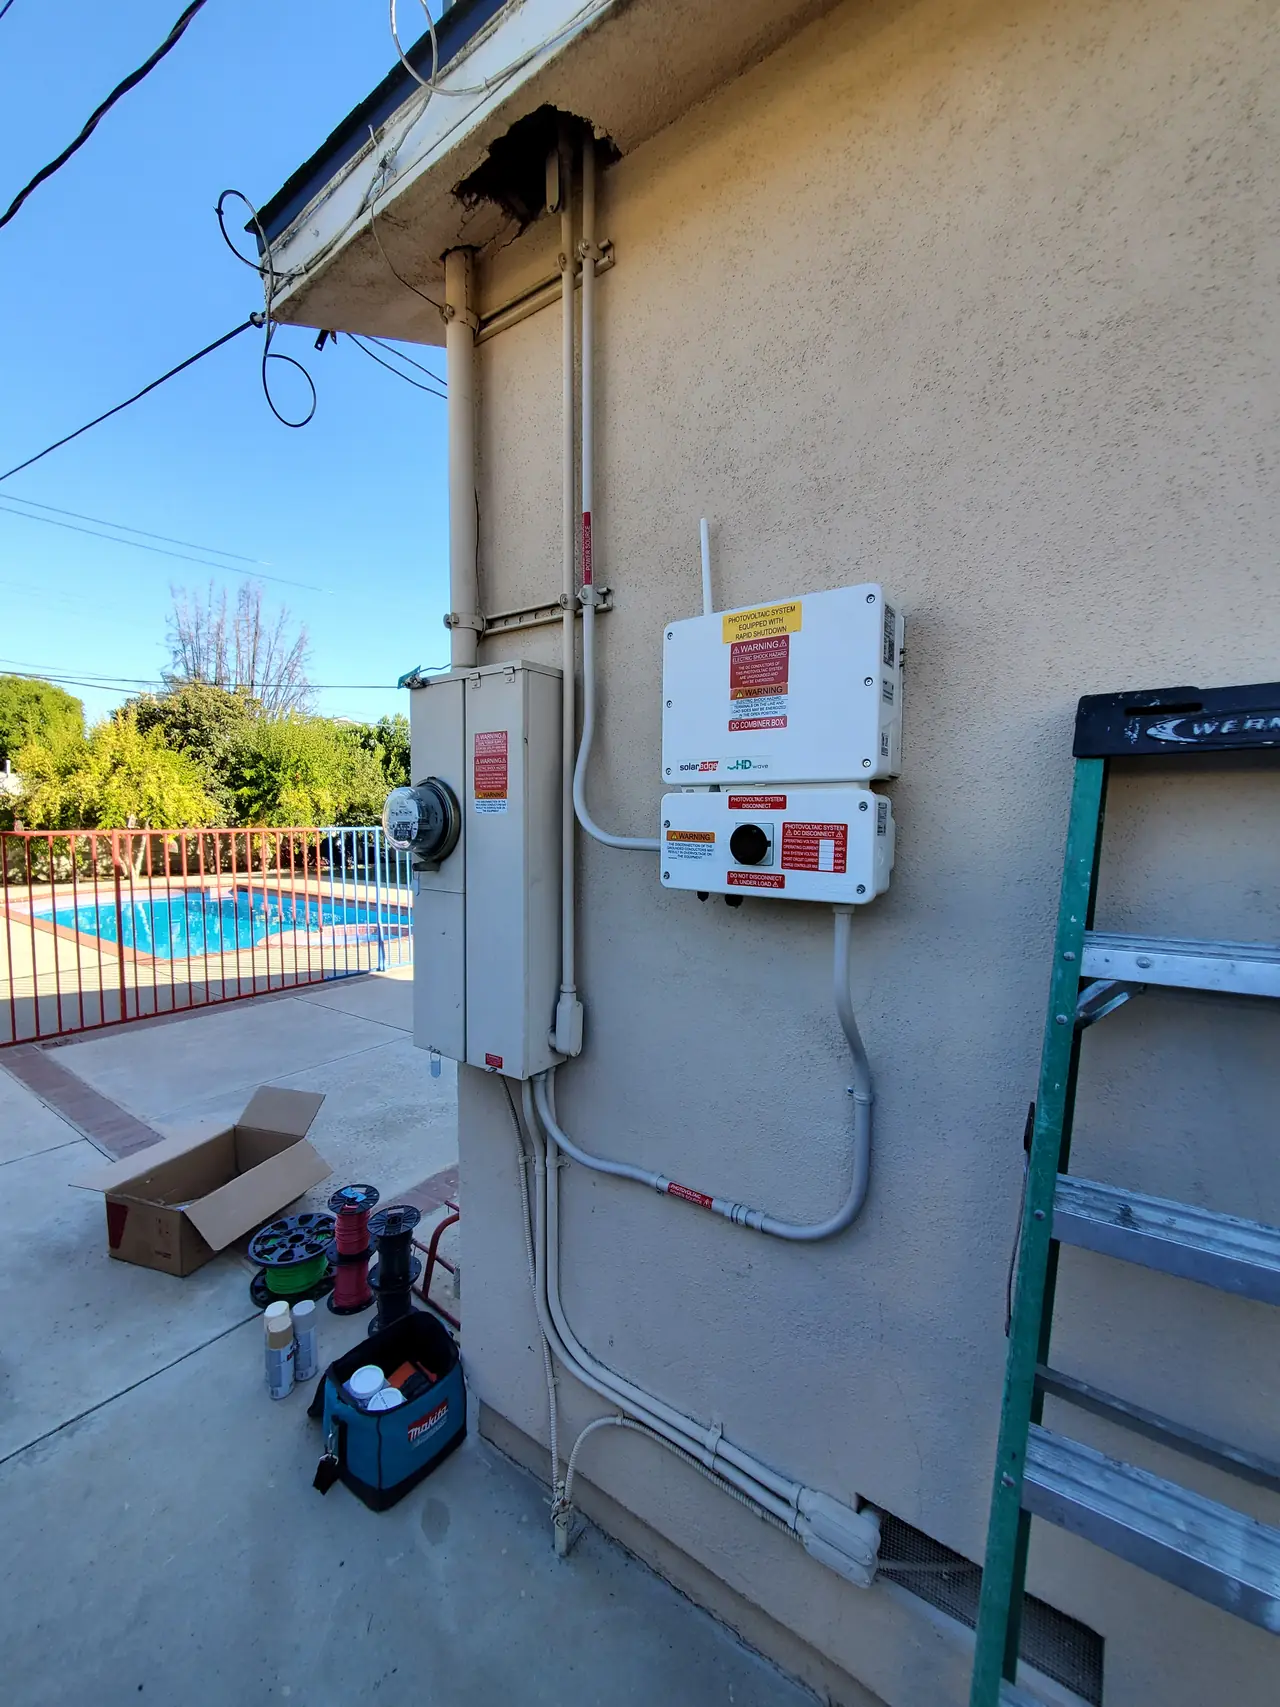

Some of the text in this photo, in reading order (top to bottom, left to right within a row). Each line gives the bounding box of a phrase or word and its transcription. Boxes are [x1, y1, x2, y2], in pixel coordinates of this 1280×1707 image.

[728, 605, 796, 624] PHOTOVOLTAIC SYSTEM
[738, 617, 784, 631] EQUIPPED WITH
[735, 625, 787, 641] RAPID SHUTDOWN
[740, 640, 779, 653] WARNING
[733, 650, 787, 664] ELECTRIC SHOCK HAZARD
[744, 686, 783, 697] WARNING
[731, 718, 785, 730] DC COMBINER BOX
[678, 832, 711, 841] WARNING
[670, 1184, 702, 1200] PHOTOVOLTAIC
